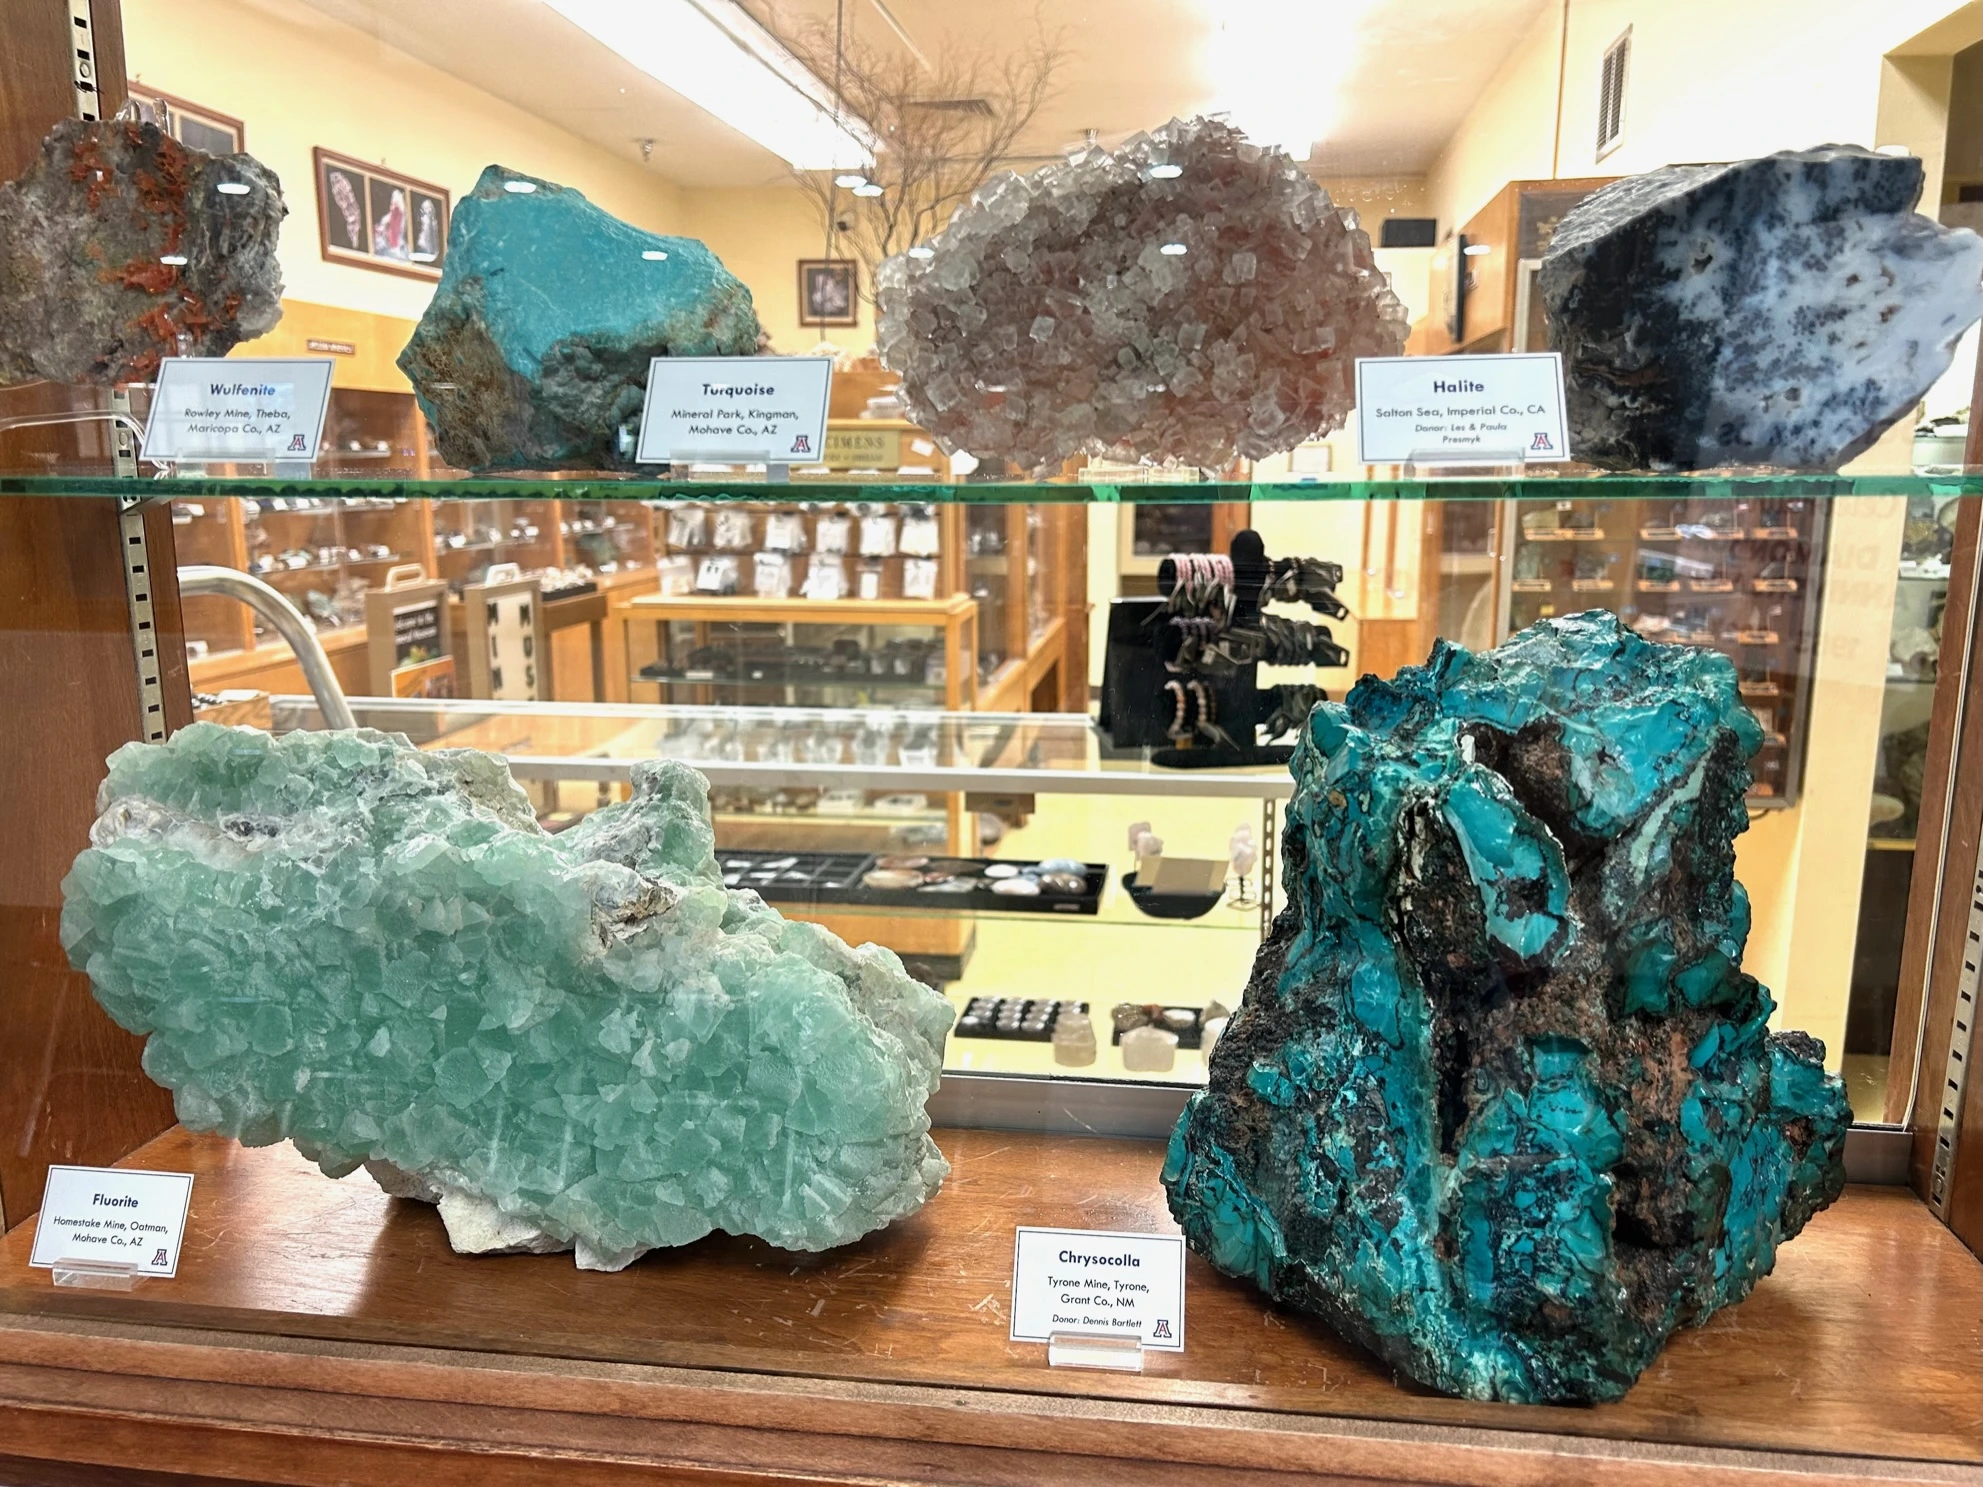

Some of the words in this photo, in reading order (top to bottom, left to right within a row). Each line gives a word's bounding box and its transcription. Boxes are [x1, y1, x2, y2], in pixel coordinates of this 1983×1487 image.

[210, 383, 275, 396] Wulfenite
[702, 383, 775, 398] Turquoise
[1434, 380, 1485, 393] Halite
[184, 408, 220, 419] Rowley
[224, 409, 252, 420] Mine,
[256, 409, 291, 420] Theba,
[671, 408, 713, 420] Mineral
[716, 408, 745, 421] Park,
[748, 409, 799, 422] Kingman,
[1375, 408, 1412, 418] Salton
[1416, 407, 1443, 418] Sea,
[1447, 406, 1496, 419] Imperial
[1500, 405, 1524, 416] Co.,
[1527, 405, 1546, 415] CA
[187, 424, 239, 435] Maricopa
[243, 424, 262, 435] Co.,
[266, 424, 281, 434] AZ
[688, 424, 733, 435] Mohave
[736, 424, 758, 437] Co.,
[761, 424, 778, 435] AZ
[1415, 423, 1447, 432] Donor:
[1451, 423, 1465, 432] Les
[1469, 423, 1476, 432] &
[1480, 423, 1507, 432] Paula
[1442, 435, 1481, 444] Presmyk
[92, 1193, 139, 1208] Fluorite
[53, 1216, 101, 1228] Homestake
[103, 1220, 127, 1231] Mine,
[130, 1221, 168, 1234] Oatman,
[72, 1233, 107, 1245] Mohave
[110, 1235, 127, 1247] Co.,
[129, 1237, 144, 1246] AZ
[1058, 1250, 1140, 1268] Chrysocolla
[1047, 1276, 1081, 1288] Tyrone
[1084, 1279, 1111, 1291] Mine,
[1113, 1280, 1150, 1293] Tyrone,
[1060, 1294, 1090, 1305] Grant
[1093, 1296, 1113, 1308] Co.,
[1116, 1297, 1135, 1307] NM
[1052, 1314, 1080, 1324] Donor:
[1083, 1316, 1109, 1326] Dennis
[1112, 1318, 1142, 1328] Bartlett
